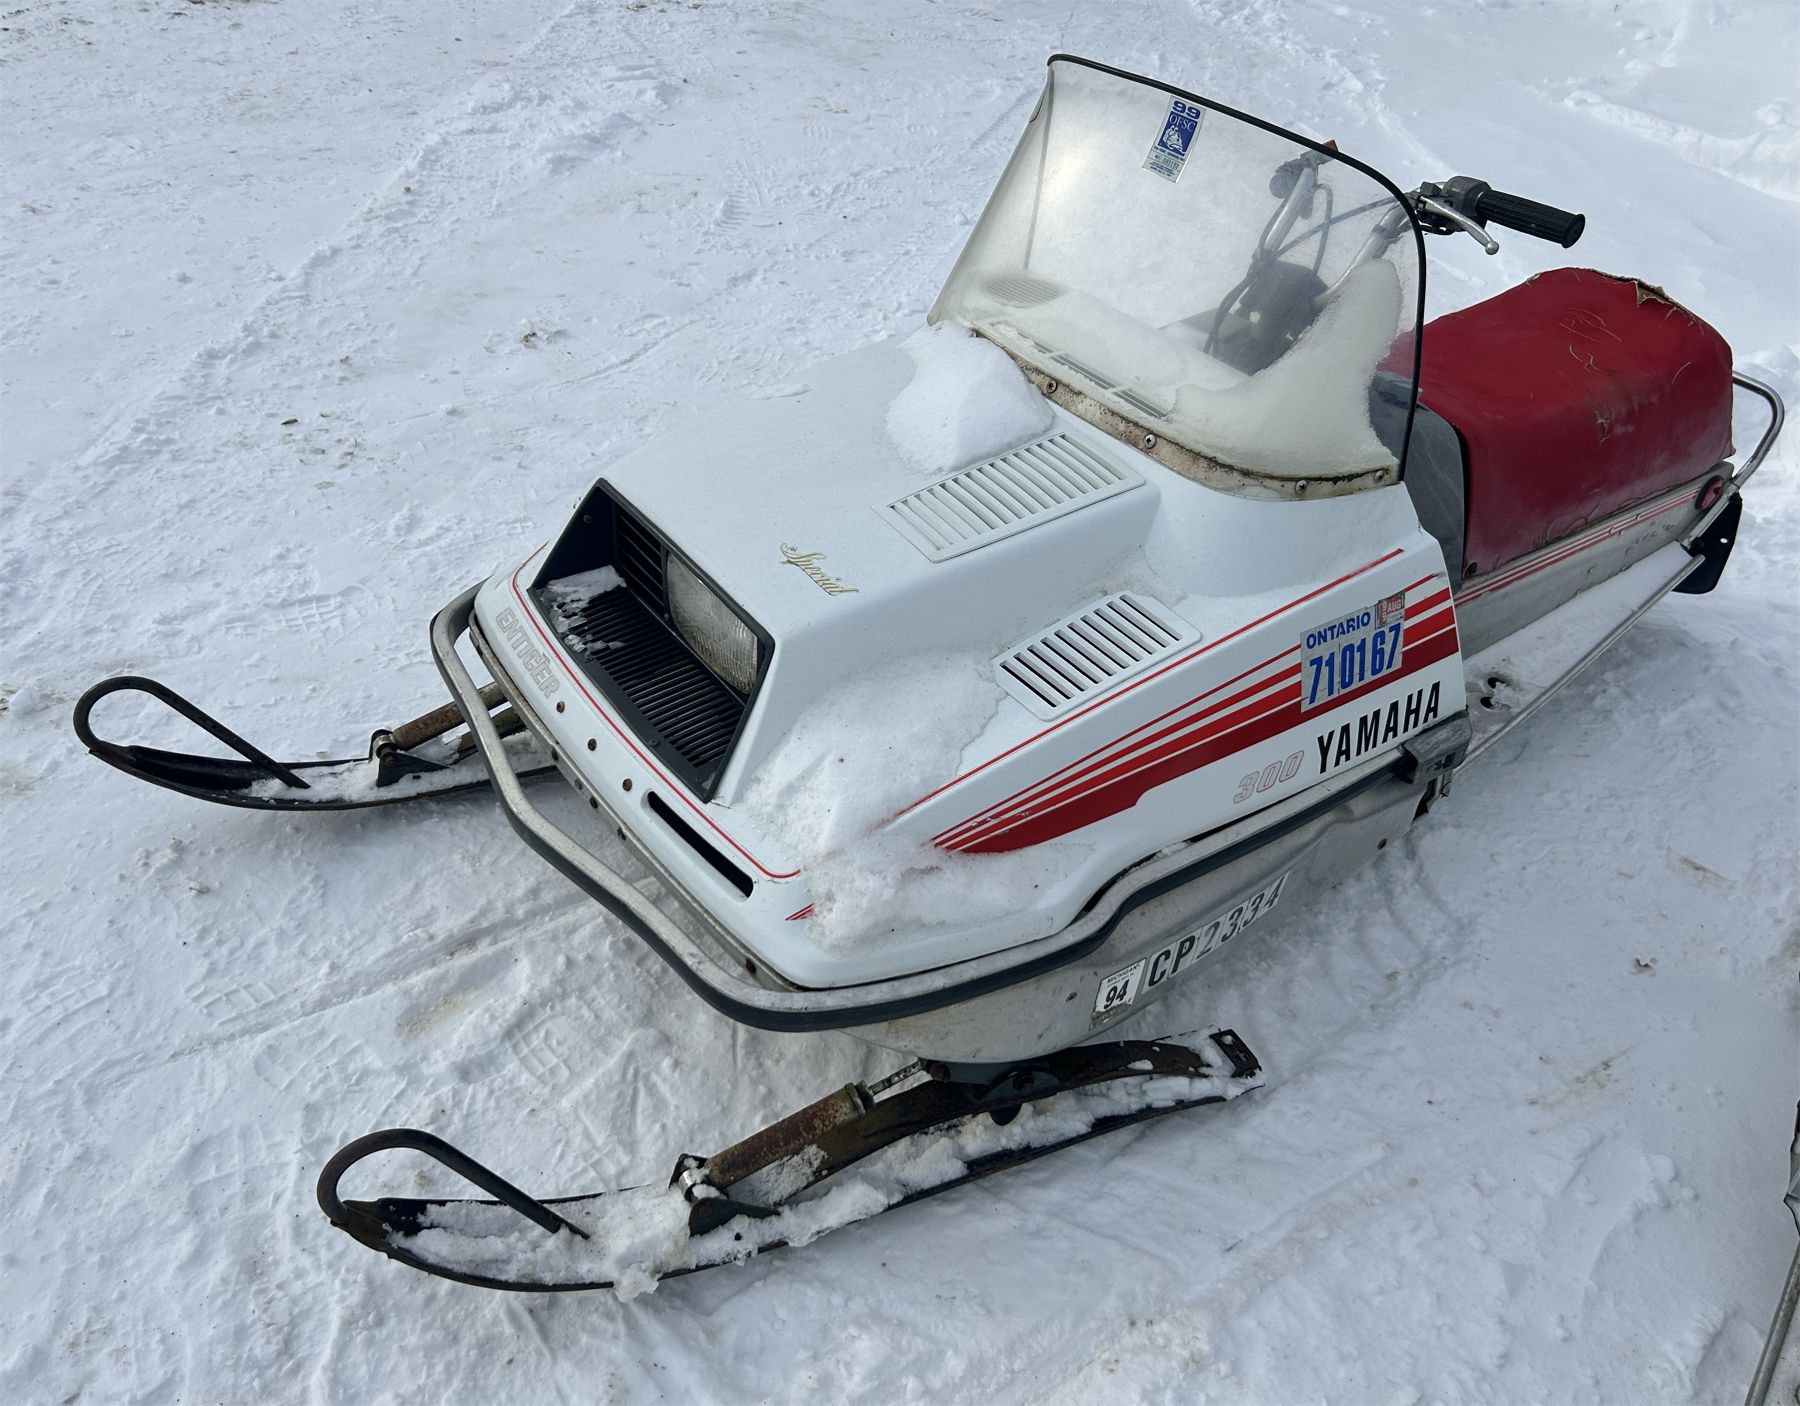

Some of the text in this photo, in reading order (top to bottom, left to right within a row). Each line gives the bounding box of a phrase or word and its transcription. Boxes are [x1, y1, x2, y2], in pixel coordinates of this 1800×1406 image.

[1169, 113, 1196, 132] OFSC
[1172, 100, 1201, 120] 99
[495, 606, 561, 699] ENTICER
[1306, 611, 1371, 649] ONTARIO
[1308, 622, 1401, 705] 710167
[1317, 681, 1441, 774] YAMAHA
[1233, 750, 1305, 804] 300
[1103, 979, 1130, 1010] 94
